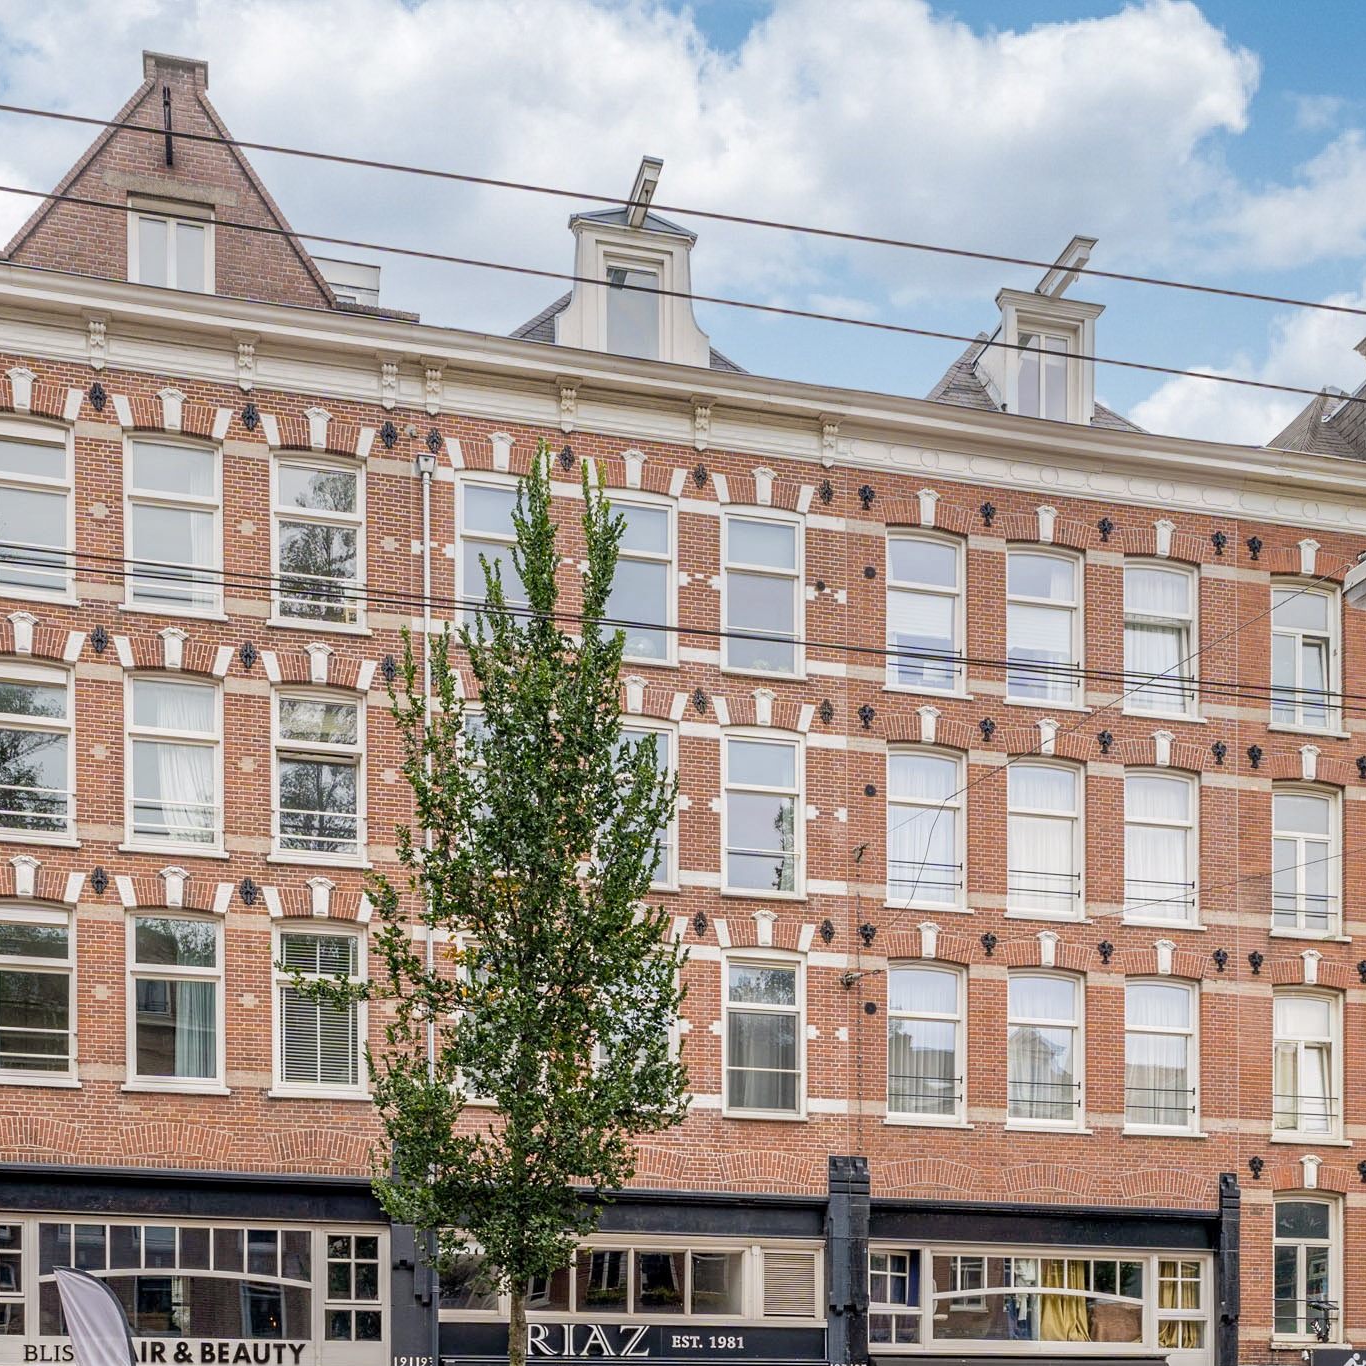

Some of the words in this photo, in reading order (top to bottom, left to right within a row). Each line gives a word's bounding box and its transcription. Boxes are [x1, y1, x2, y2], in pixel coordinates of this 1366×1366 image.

[23, 1344, 74, 1362] BLIS
[173, 1341, 194, 1364] &
[201, 1342, 306, 1365] BEAUTY
[527, 1323, 650, 1357] RIAZ
[672, 1335, 703, 1348] EST.
[709, 1336, 744, 1349] 1981
